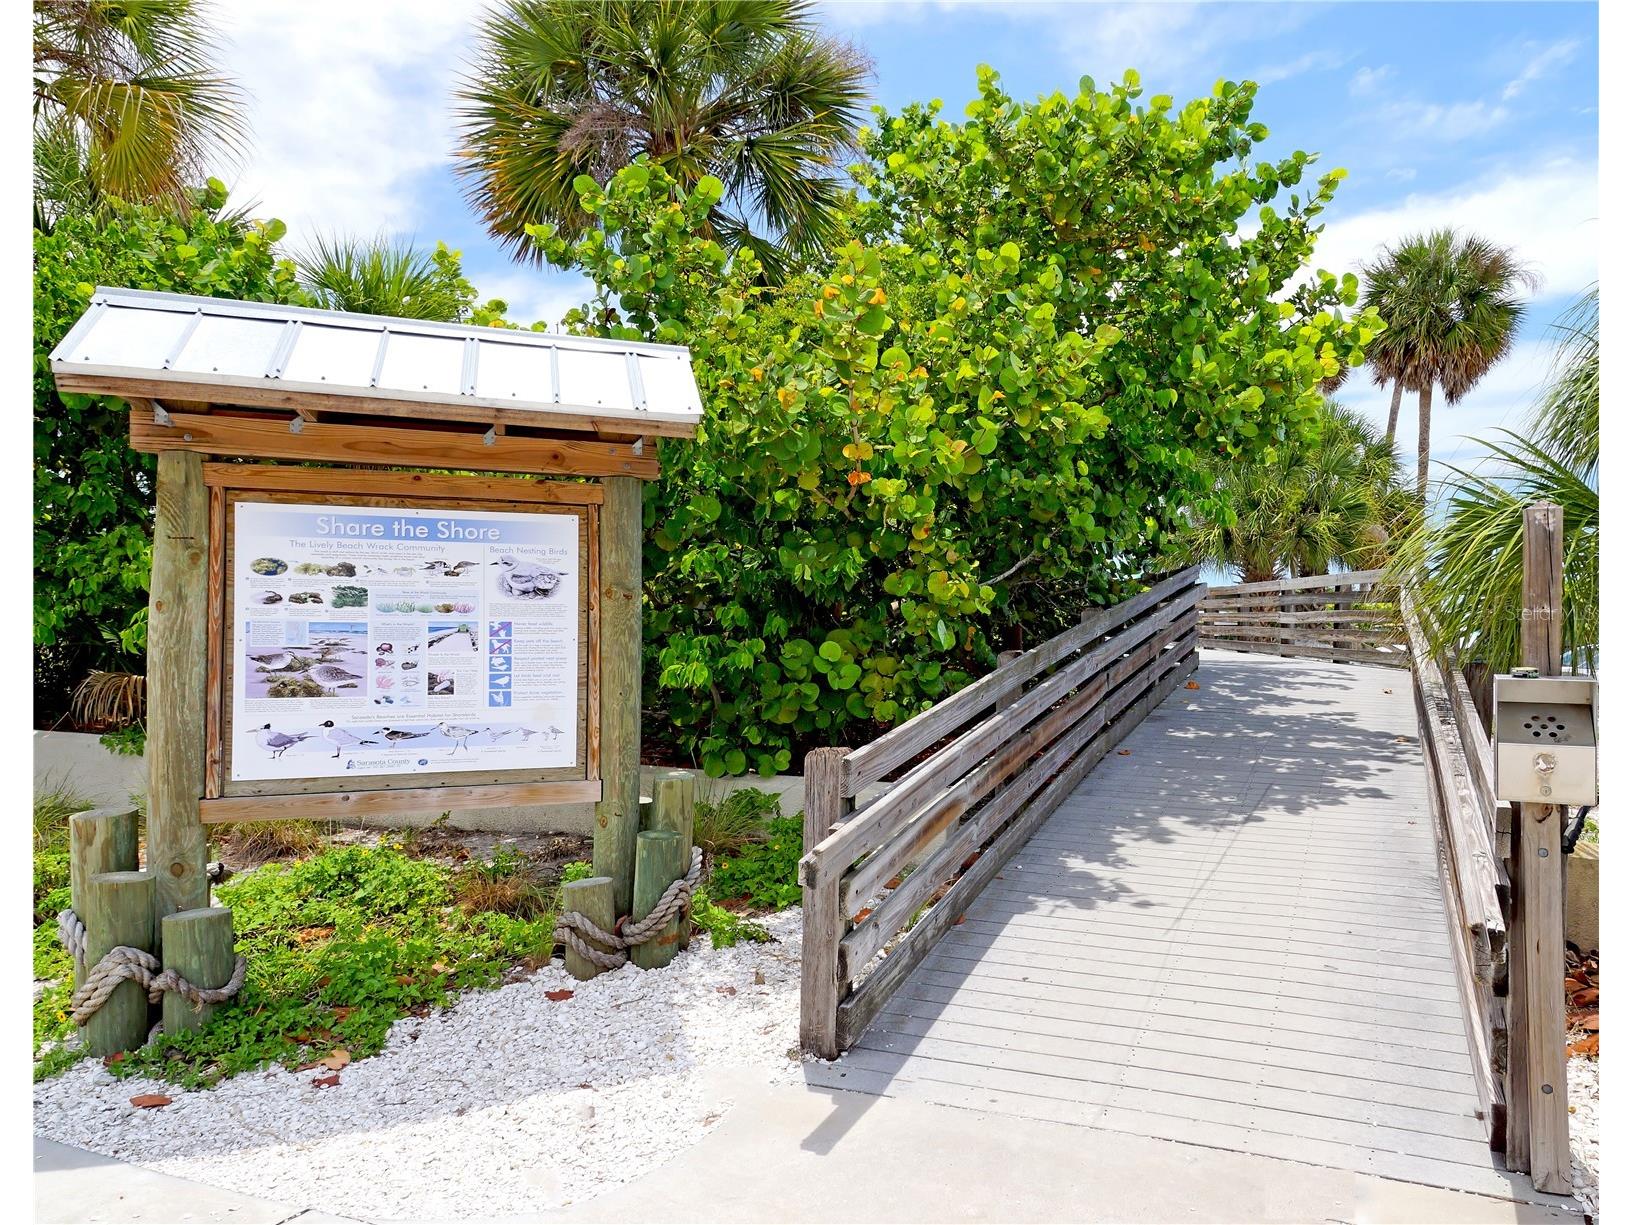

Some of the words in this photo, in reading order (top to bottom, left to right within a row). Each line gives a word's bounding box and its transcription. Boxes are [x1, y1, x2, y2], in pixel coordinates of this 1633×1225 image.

[315, 516, 385, 537] Share
[392, 518, 429, 538] the
[436, 520, 501, 540] Shore
[289, 539, 306, 548] The
[309, 540, 334, 550] Lively
[336, 541, 363, 549] Beach
[366, 542, 394, 551] Wrack
[396, 543, 446, 553] Community
[489, 545, 514, 554] Beach
[516, 546, 546, 556] Nesting
[549, 548, 568, 556] Birds
